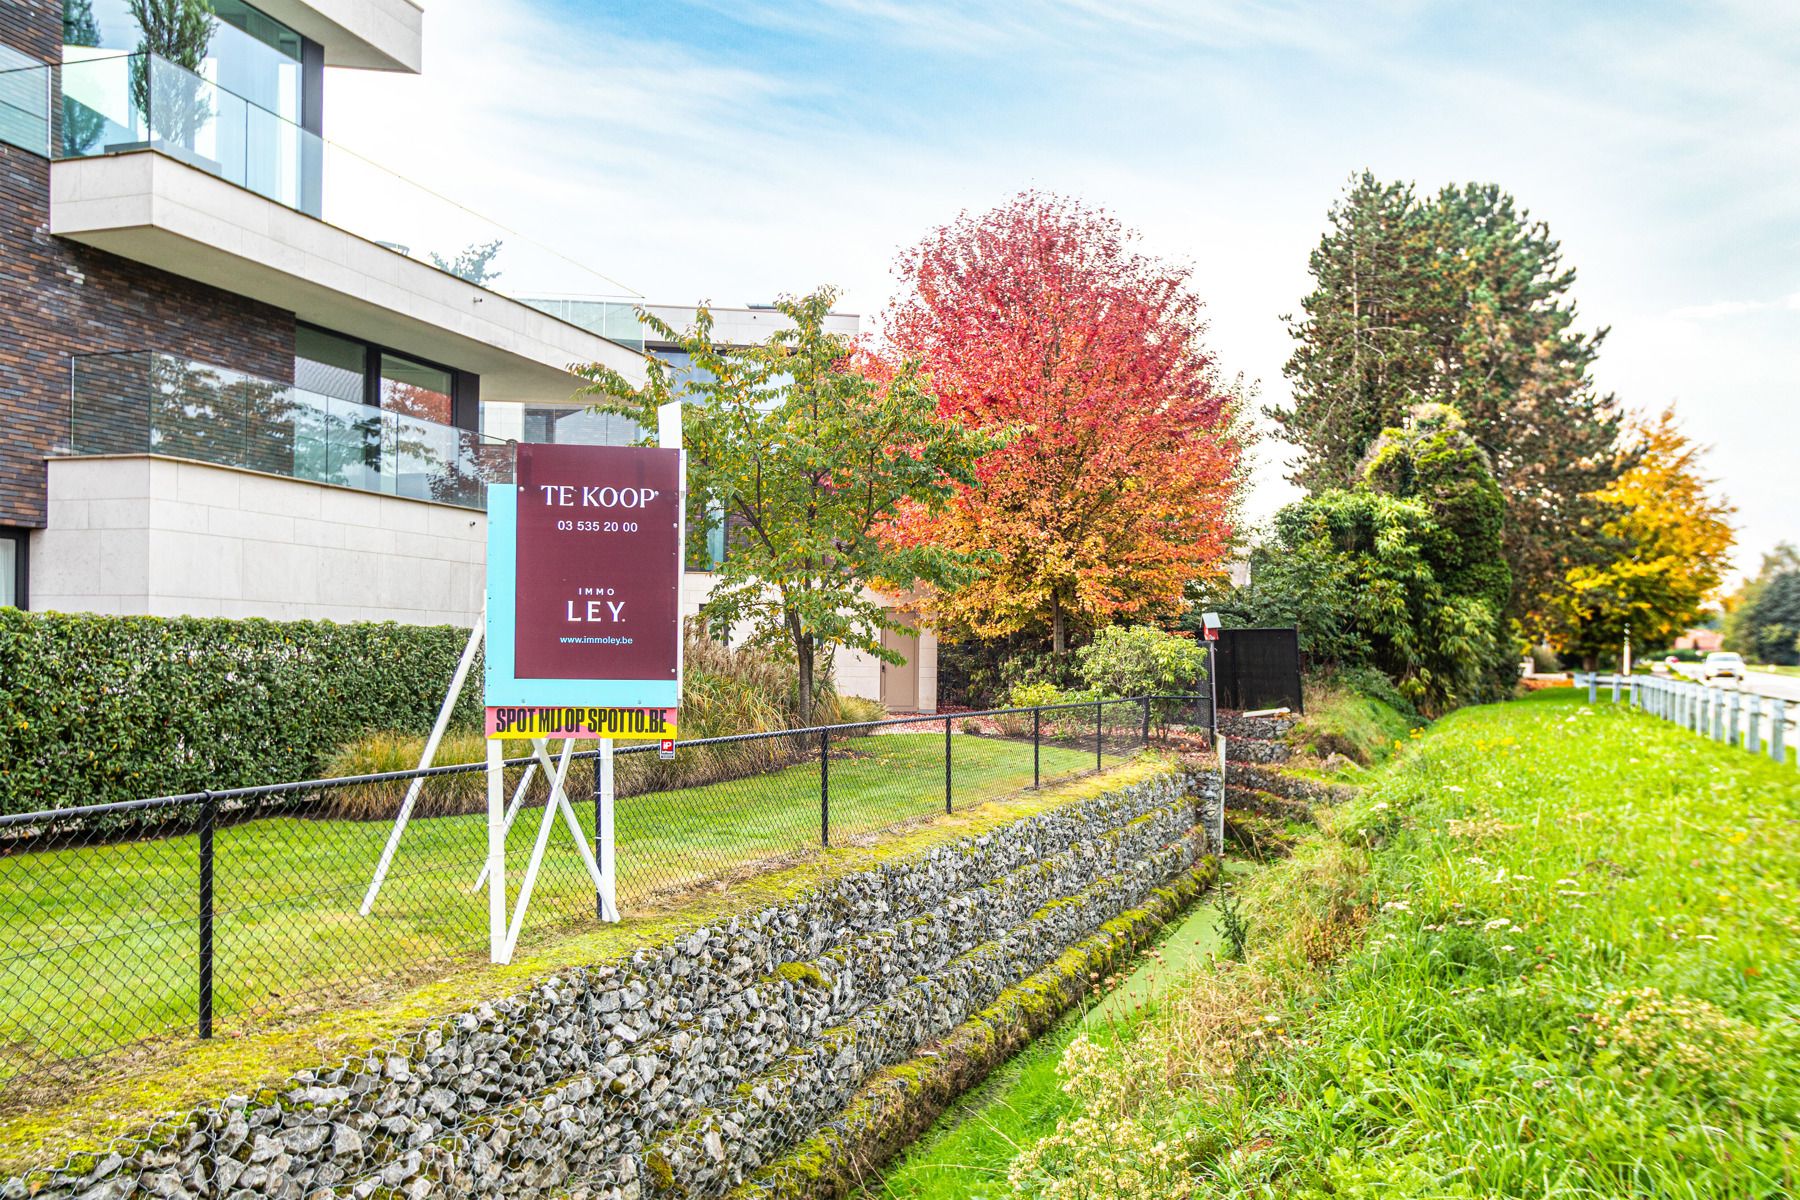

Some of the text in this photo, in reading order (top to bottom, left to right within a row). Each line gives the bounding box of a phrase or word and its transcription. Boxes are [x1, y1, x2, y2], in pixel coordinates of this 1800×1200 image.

[540, 485, 656, 508] TE KOOP
[557, 520, 638, 533] 03 535 20 00
[578, 587, 615, 596] IMMO
[560, 636, 633, 646] www.immoley.be
[496, 708, 667, 733] SPOT MIJ OP SPOTTO.BE
